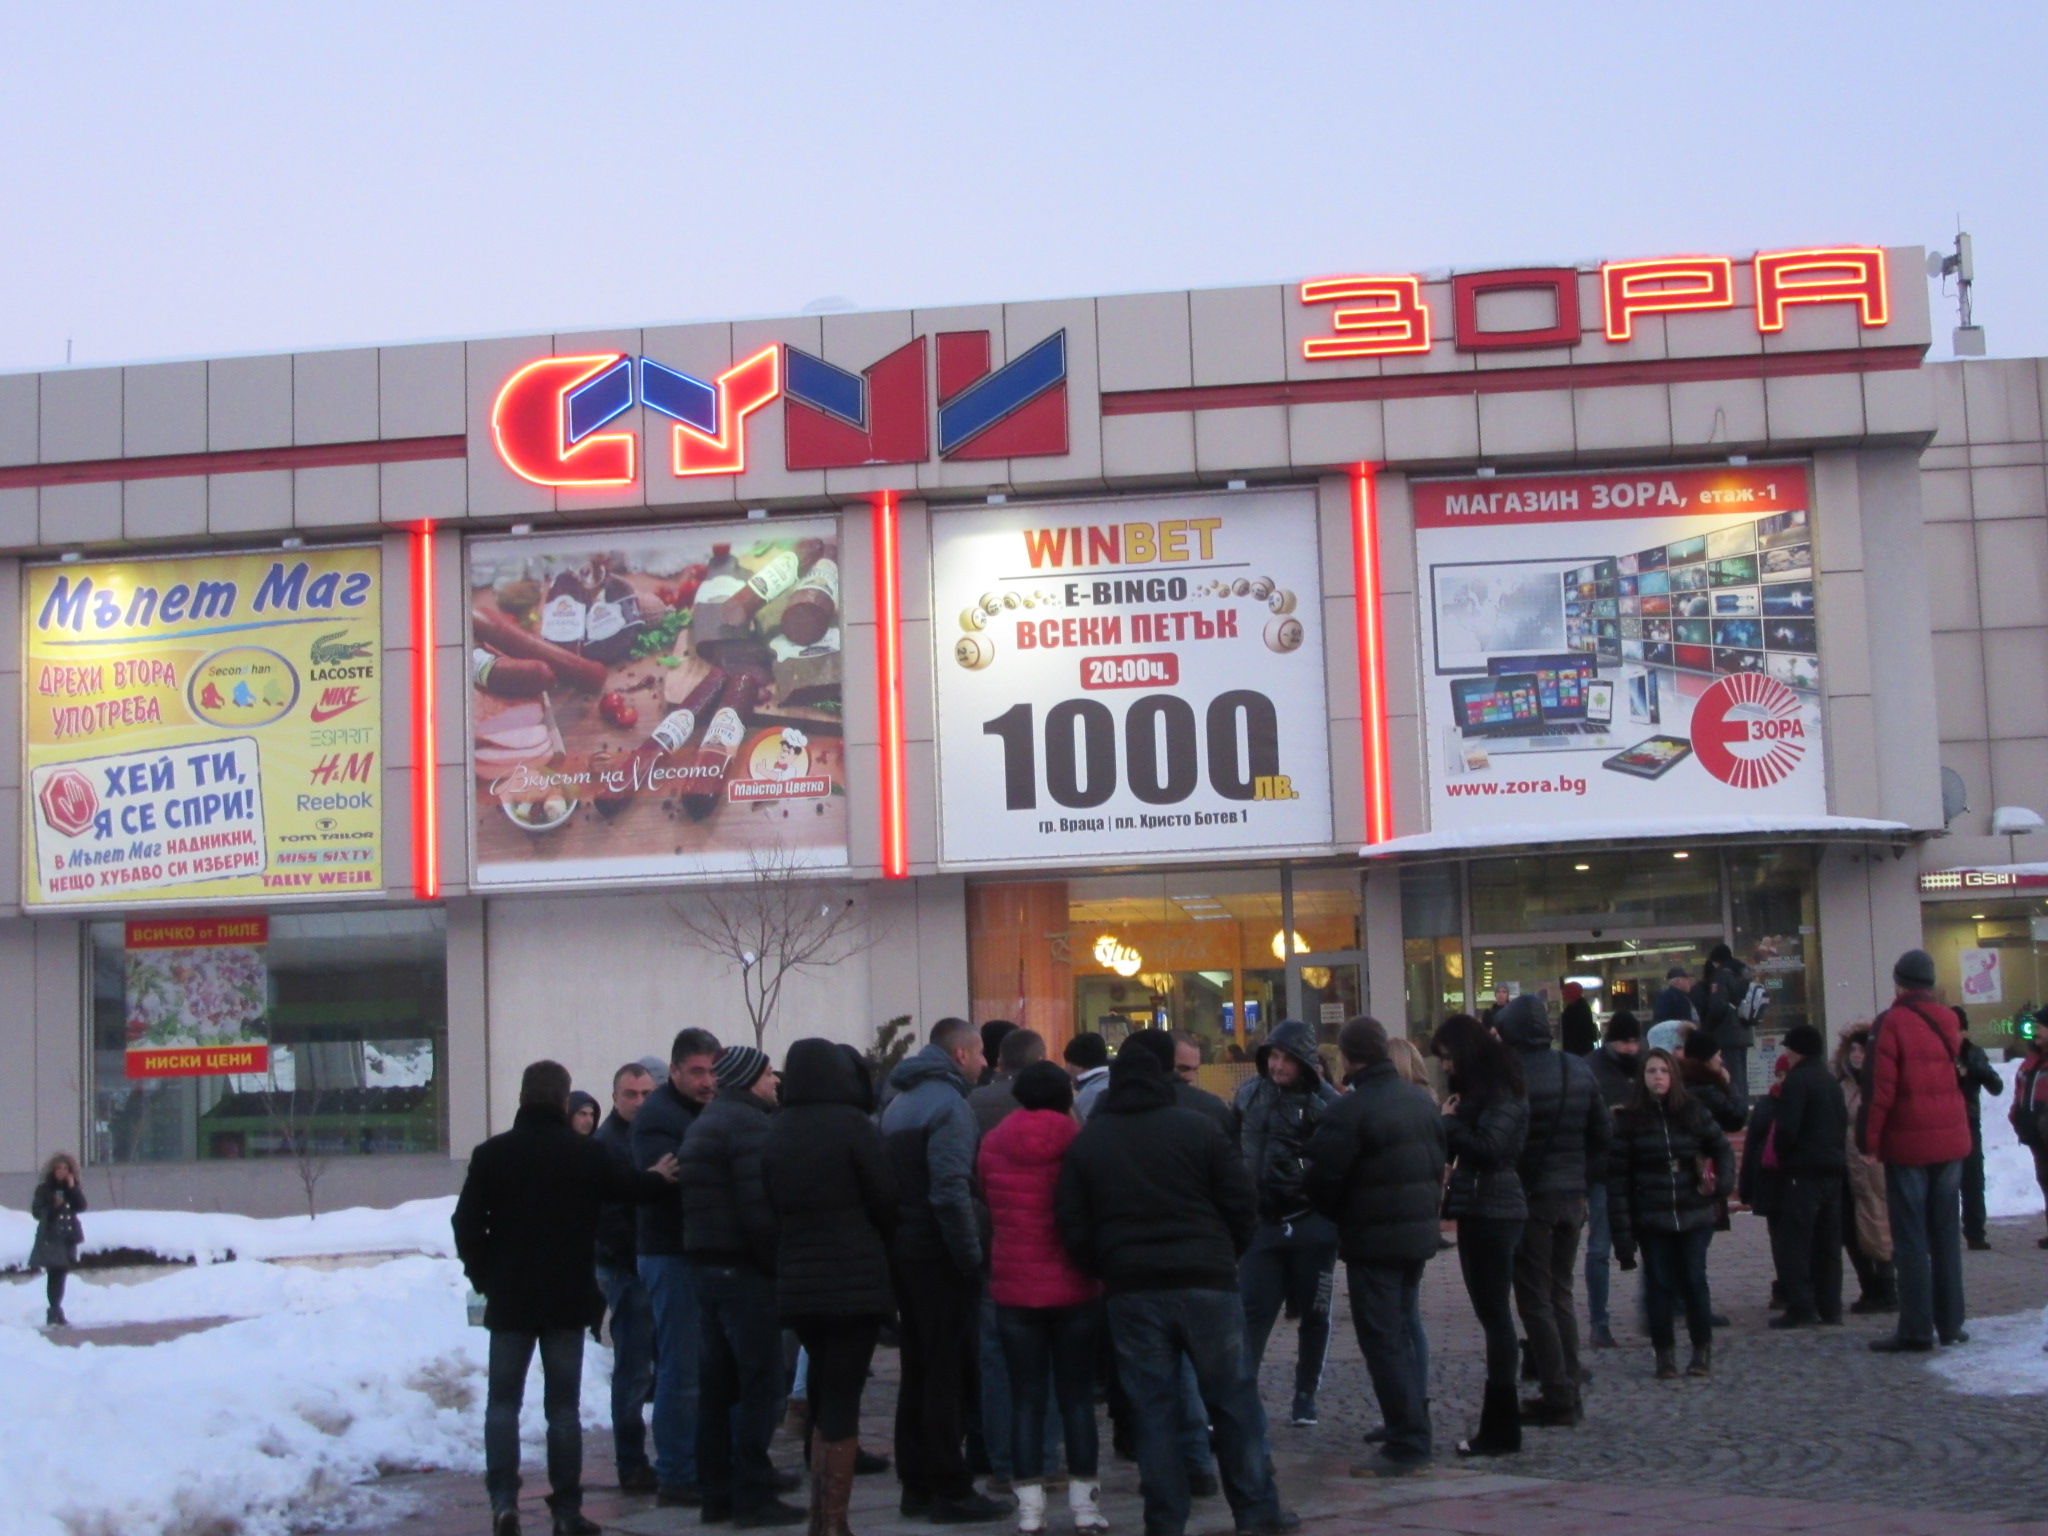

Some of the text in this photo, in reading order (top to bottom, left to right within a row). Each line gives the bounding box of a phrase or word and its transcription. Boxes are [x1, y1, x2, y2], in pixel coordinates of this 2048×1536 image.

[1301, 246, 1889, 358] ЗОРА
[1445, 481, 1777, 516] МАГАЗИН ЗОРА, етаж -1
[1023, 517, 1222, 568] WINBET
[38, 562, 372, 633] Мъпет Маг
[1064, 577, 1188, 607] E-BINGO
[1016, 609, 1238, 650] ВСЕКИ ПЕТЪК
[38, 660, 178, 696] ДРЕХИ ВТОРА
[310, 666, 374, 681] LACOSTE
[1089, 658, 1170, 684] 20:00ч.
[319, 686, 360, 706] NIKE
[51, 695, 163, 738] УПОТРЕБА
[1750, 718, 1804, 739] ЗОРА
[310, 727, 374, 747] ESPRIT
[982, 689, 1281, 811] 1000
[104, 750, 247, 799] ХЕЙ ТИ,
[310, 751, 374, 786] H&M
[490, 762, 591, 796] Вкусът
[734, 779, 825, 798] Майстор Цветко
[1446, 775, 1587, 797] www.zora.bg
[93, 788, 254, 841] Я СЕ СПРИ!
[296, 791, 374, 812] Reebok
[320, 831, 374, 840] TAILOR
[1038, 808, 1249, 834] гр. Враца пл. Христо Ботев 1
[68, 848, 125, 869] Мъпет
[128, 841, 162, 860] Маг
[166, 829, 257, 855] НАДНИКНИ,
[277, 849, 371, 864] MISS SIXTY
[50, 850, 260, 893] НЕЩО ХУБАВО СИ ИЗБЕРИ!
[261, 873, 313, 887] TALLY
[132, 923, 260, 942] ВСИЧКО от ПИЛЕ
[145, 1052, 253, 1070] НИСКИ ЦЕНИ
